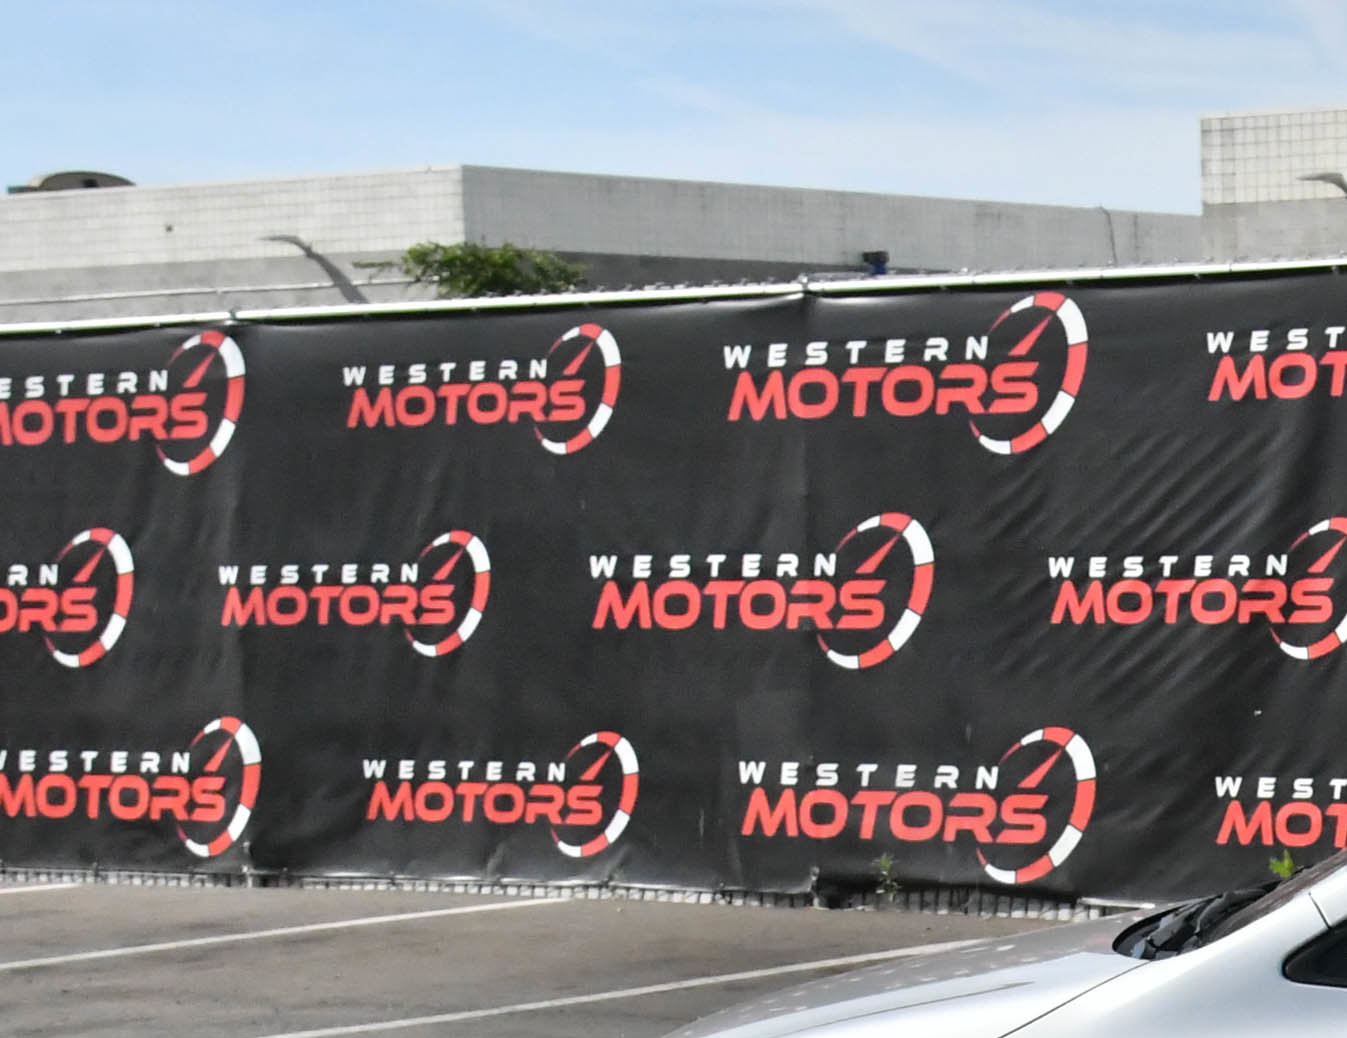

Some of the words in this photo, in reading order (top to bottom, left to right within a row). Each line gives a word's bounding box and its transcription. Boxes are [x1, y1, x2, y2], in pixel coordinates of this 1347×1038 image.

[342, 358, 548, 387] WESTERN
[723, 335, 989, 370] WESTERN
[0, 369, 168, 400] ESTERN
[346, 378, 587, 429] MOTORS
[727, 360, 1040, 422] MOTORS
[0, 391, 209, 446] OTORS
[218, 562, 419, 586] WESTERN
[589, 552, 837, 579] WESTERN
[1048, 554, 1288, 579] WESTERN
[220, 584, 456, 627] MOTORS
[592, 579, 887, 631] MOTORS
[1050, 577, 1335, 626] MOTORS
[362, 759, 566, 783] WESTERN
[738, 760, 999, 790] WESTERN
[0, 772, 227, 823] MOTORS
[365, 781, 604, 827] MOTORS
[740, 787, 1049, 845] MOTORS
